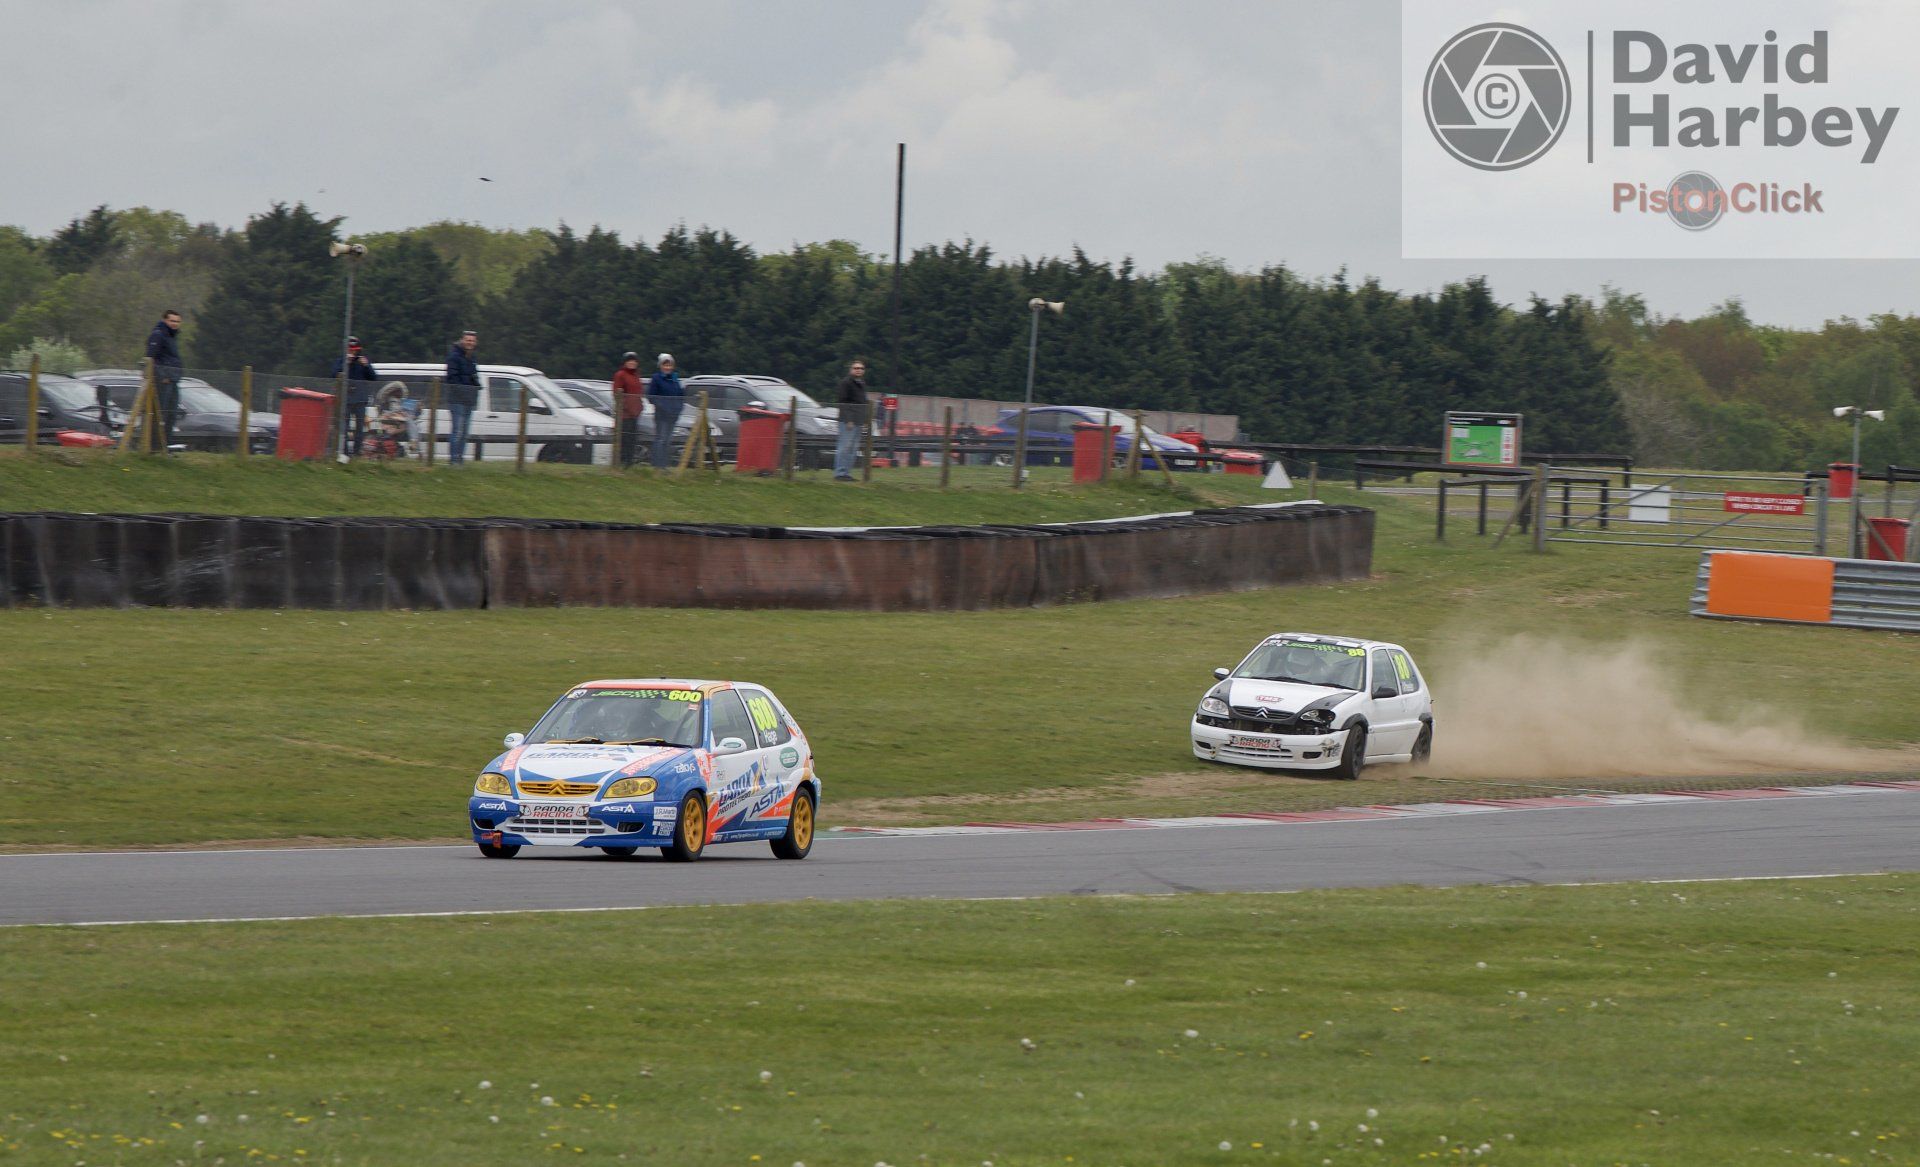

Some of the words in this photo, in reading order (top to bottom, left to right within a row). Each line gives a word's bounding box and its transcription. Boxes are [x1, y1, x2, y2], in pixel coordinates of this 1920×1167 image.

[668, 689, 702, 703] 600
[1240, 736, 1271, 744] PANDA
[478, 801, 507, 811] ASTA
[601, 803, 636, 814] ASTA
[532, 810, 573, 818] RACING
